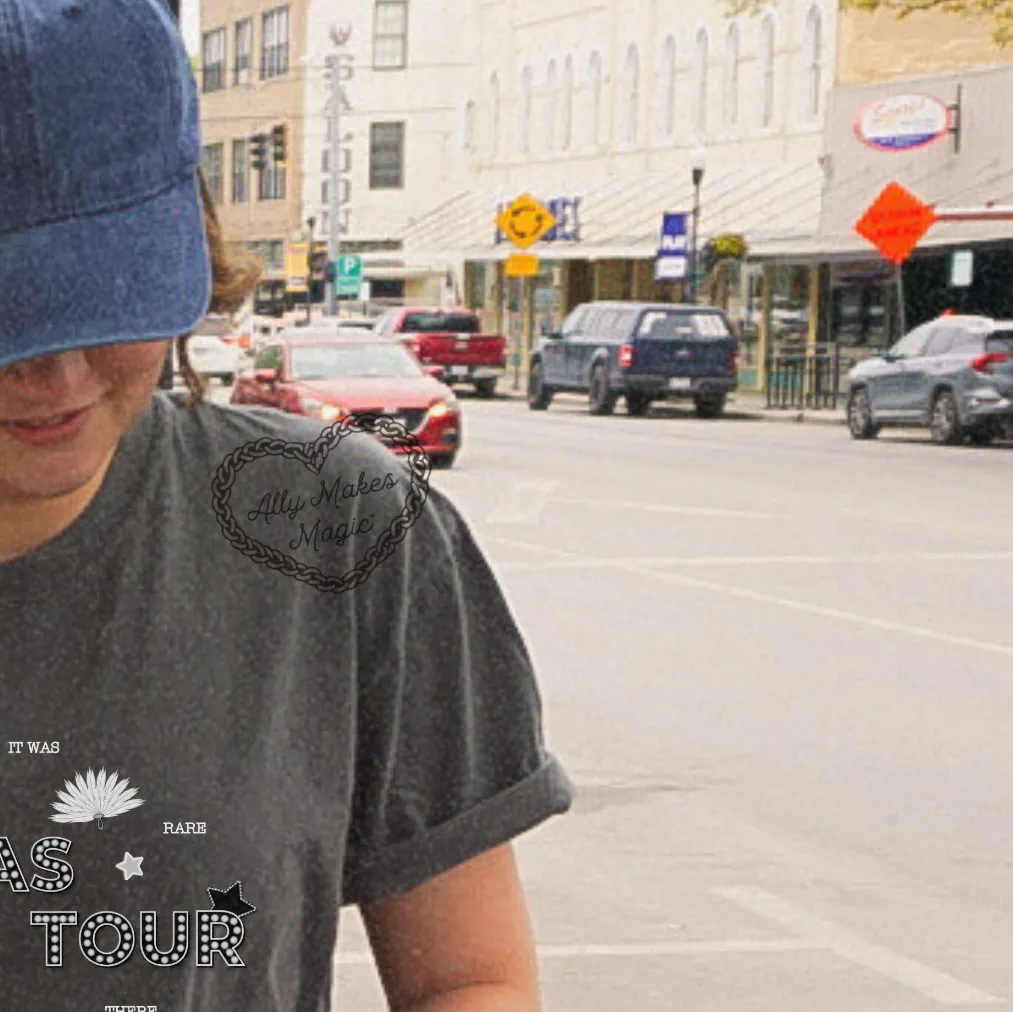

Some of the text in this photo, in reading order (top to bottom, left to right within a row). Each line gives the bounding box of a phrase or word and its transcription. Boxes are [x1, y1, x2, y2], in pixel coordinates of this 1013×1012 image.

[7, 740, 60, 753] IT WAS
[162, 821, 207, 834] RARE
[29, 909, 247, 968] TOUR
